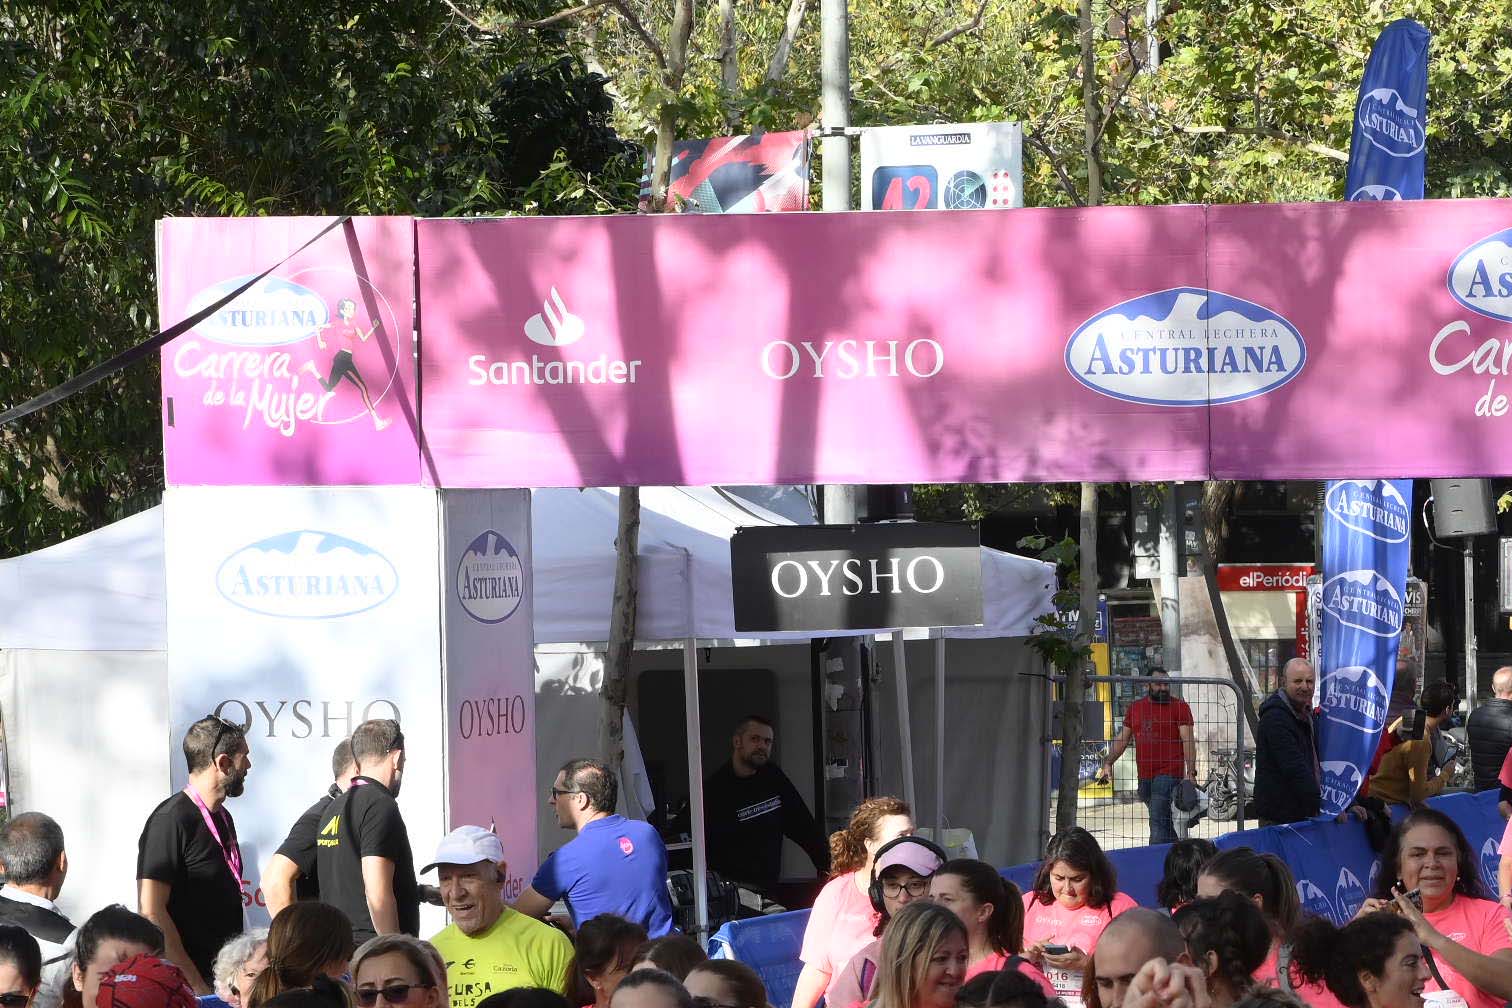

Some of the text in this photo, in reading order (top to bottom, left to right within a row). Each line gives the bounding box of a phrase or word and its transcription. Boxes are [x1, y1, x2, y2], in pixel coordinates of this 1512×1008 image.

[1084, 332, 1288, 376] ASTURIANA
[1120, 328, 1279, 341] CENTRAL LECHERA
[173, 341, 291, 379] Carrera
[468, 353, 642, 387] Santander
[760, 338, 944, 380] OYSHO
[202, 372, 336, 438] de la Mujer
[1475, 379, 1509, 417] de
[1336, 489, 1407, 535] ASTURIANA
[230, 564, 386, 598] ASTURIANA
[461, 564, 520, 600] ASTURIANA
[770, 555, 945, 598] OYSHO
[1330, 584, 1399, 629] ASTURIANA
[458, 695, 526, 741] OYSHO
